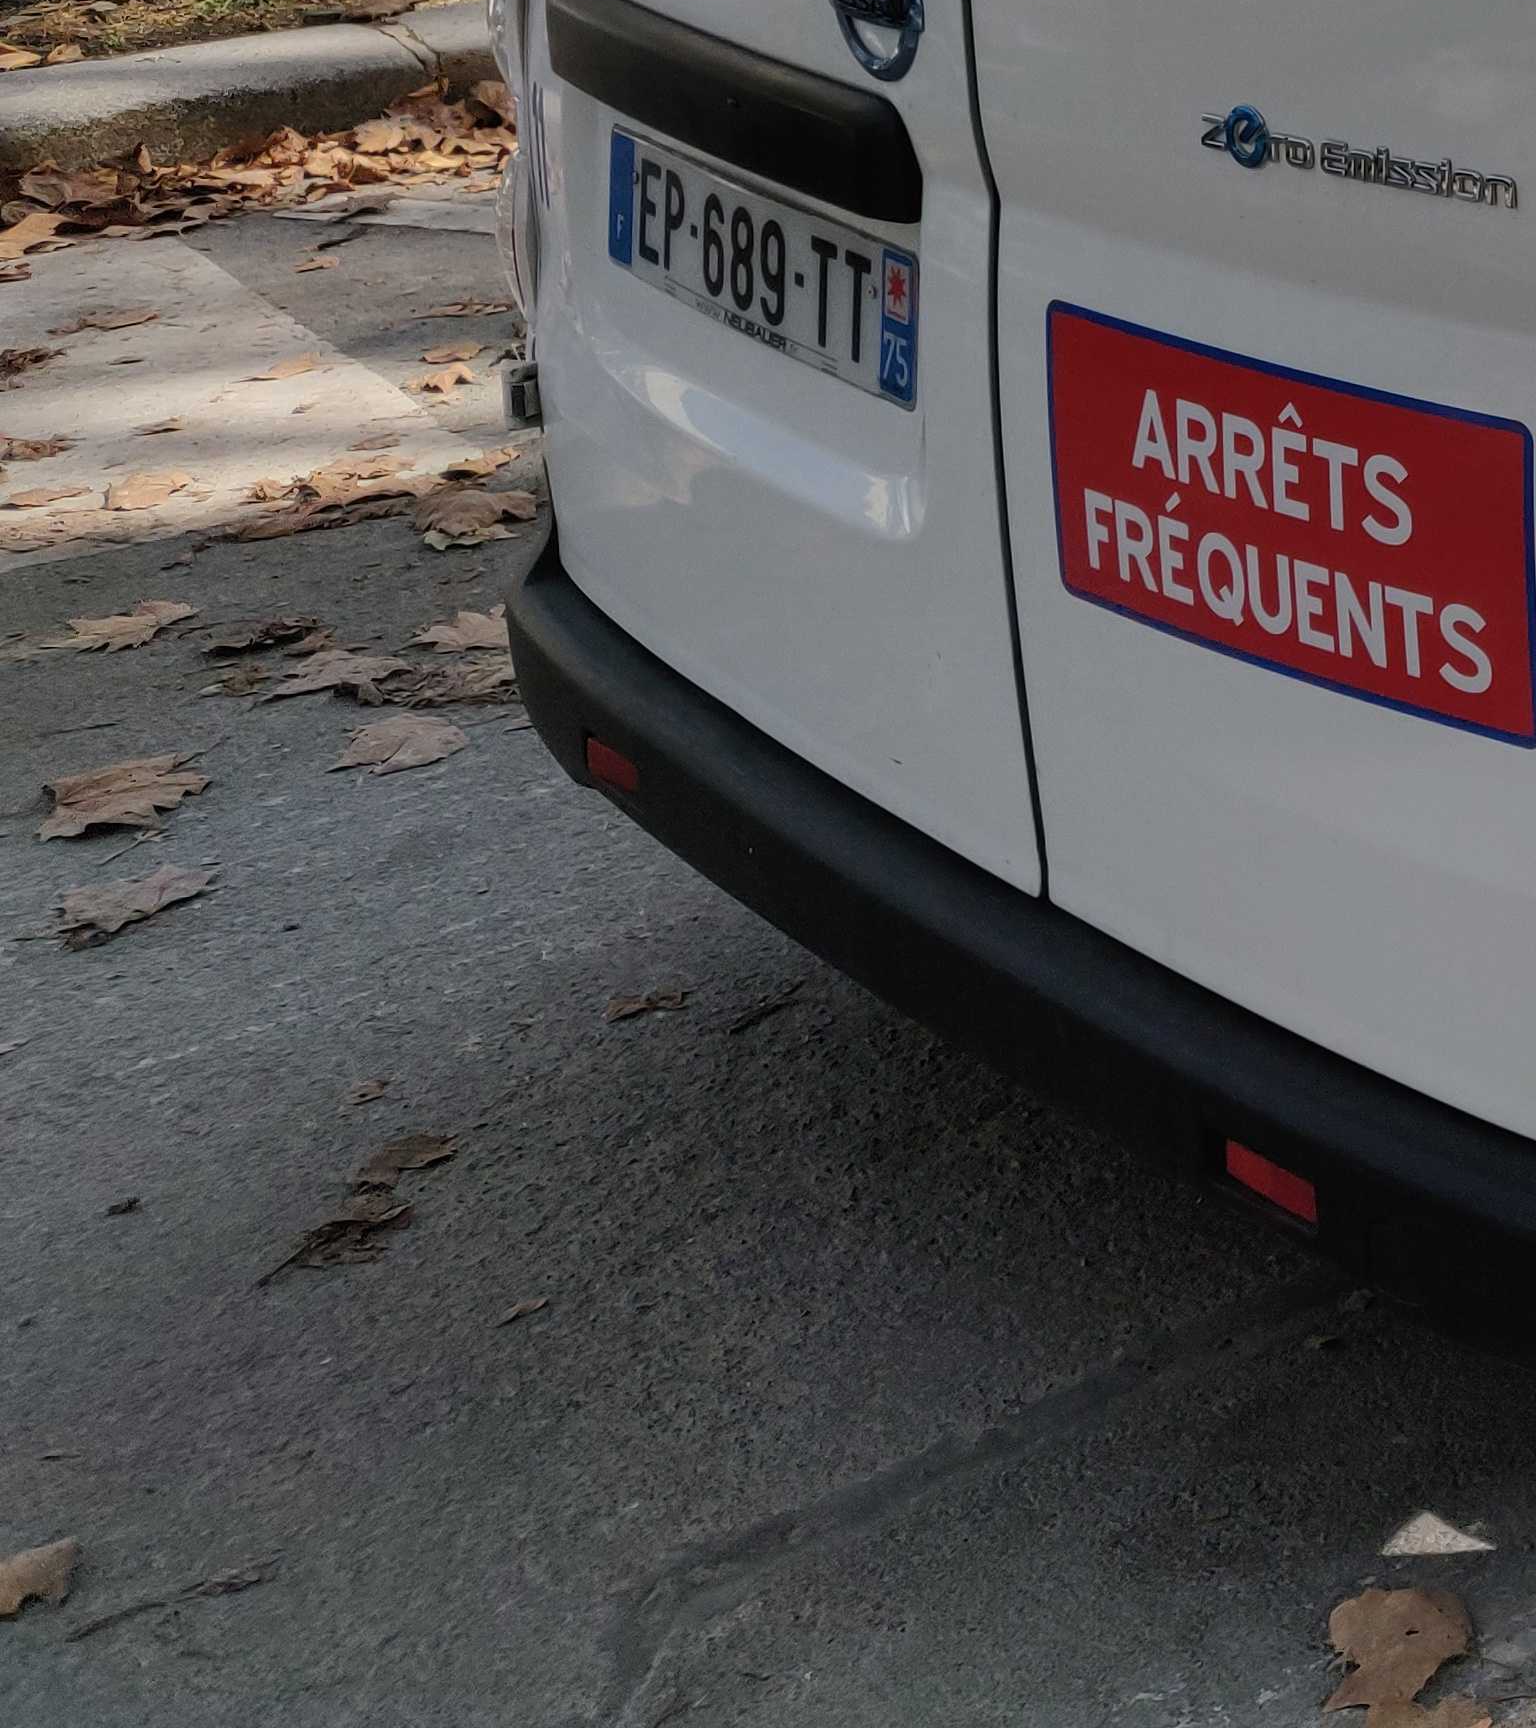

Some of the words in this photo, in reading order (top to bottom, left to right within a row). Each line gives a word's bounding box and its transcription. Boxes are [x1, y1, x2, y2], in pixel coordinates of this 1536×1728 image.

[638, 158, 872, 364] EP-689-TT
[883, 332, 908, 388] 75
[1131, 388, 1414, 547] ARRÊTS
[1083, 489, 1493, 694] FRÉQUENTS
